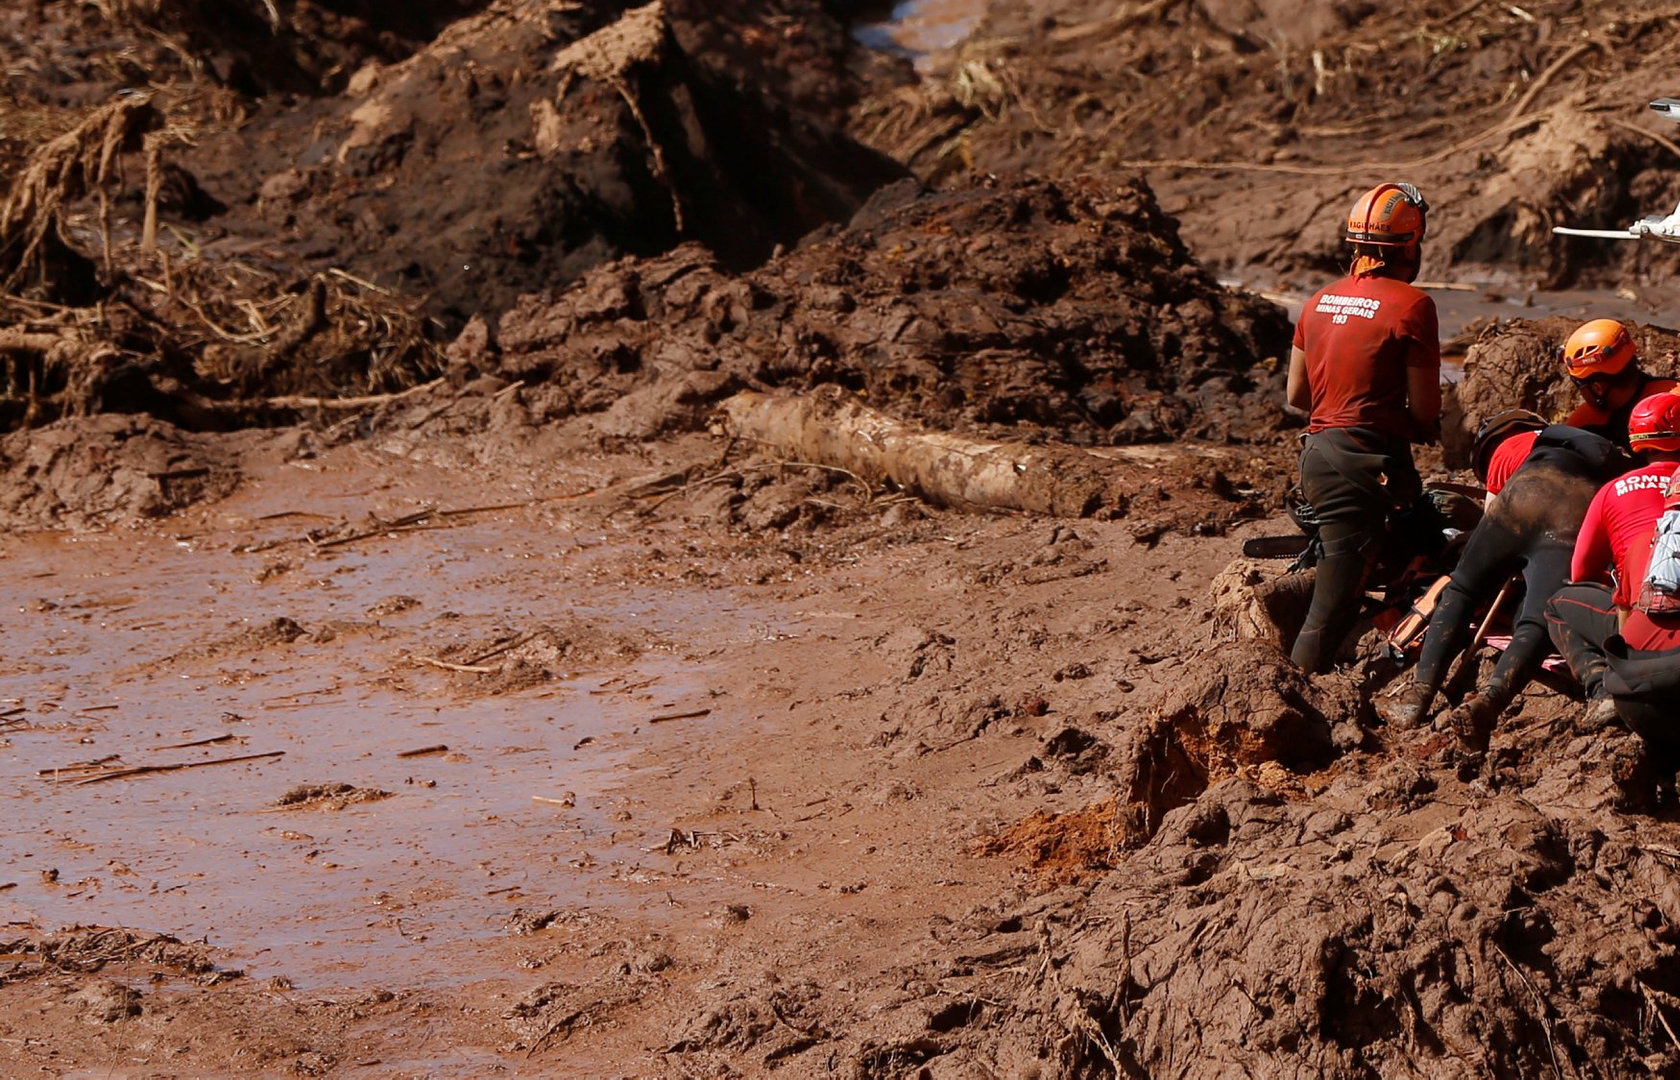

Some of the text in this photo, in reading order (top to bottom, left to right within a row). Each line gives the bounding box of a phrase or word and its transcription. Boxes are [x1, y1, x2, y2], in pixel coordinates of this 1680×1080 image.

[1320, 294, 1381, 311] BOMBEIROS
[1315, 304, 1375, 319] MINAS GERAIS
[1332, 314, 1348, 324] 193
